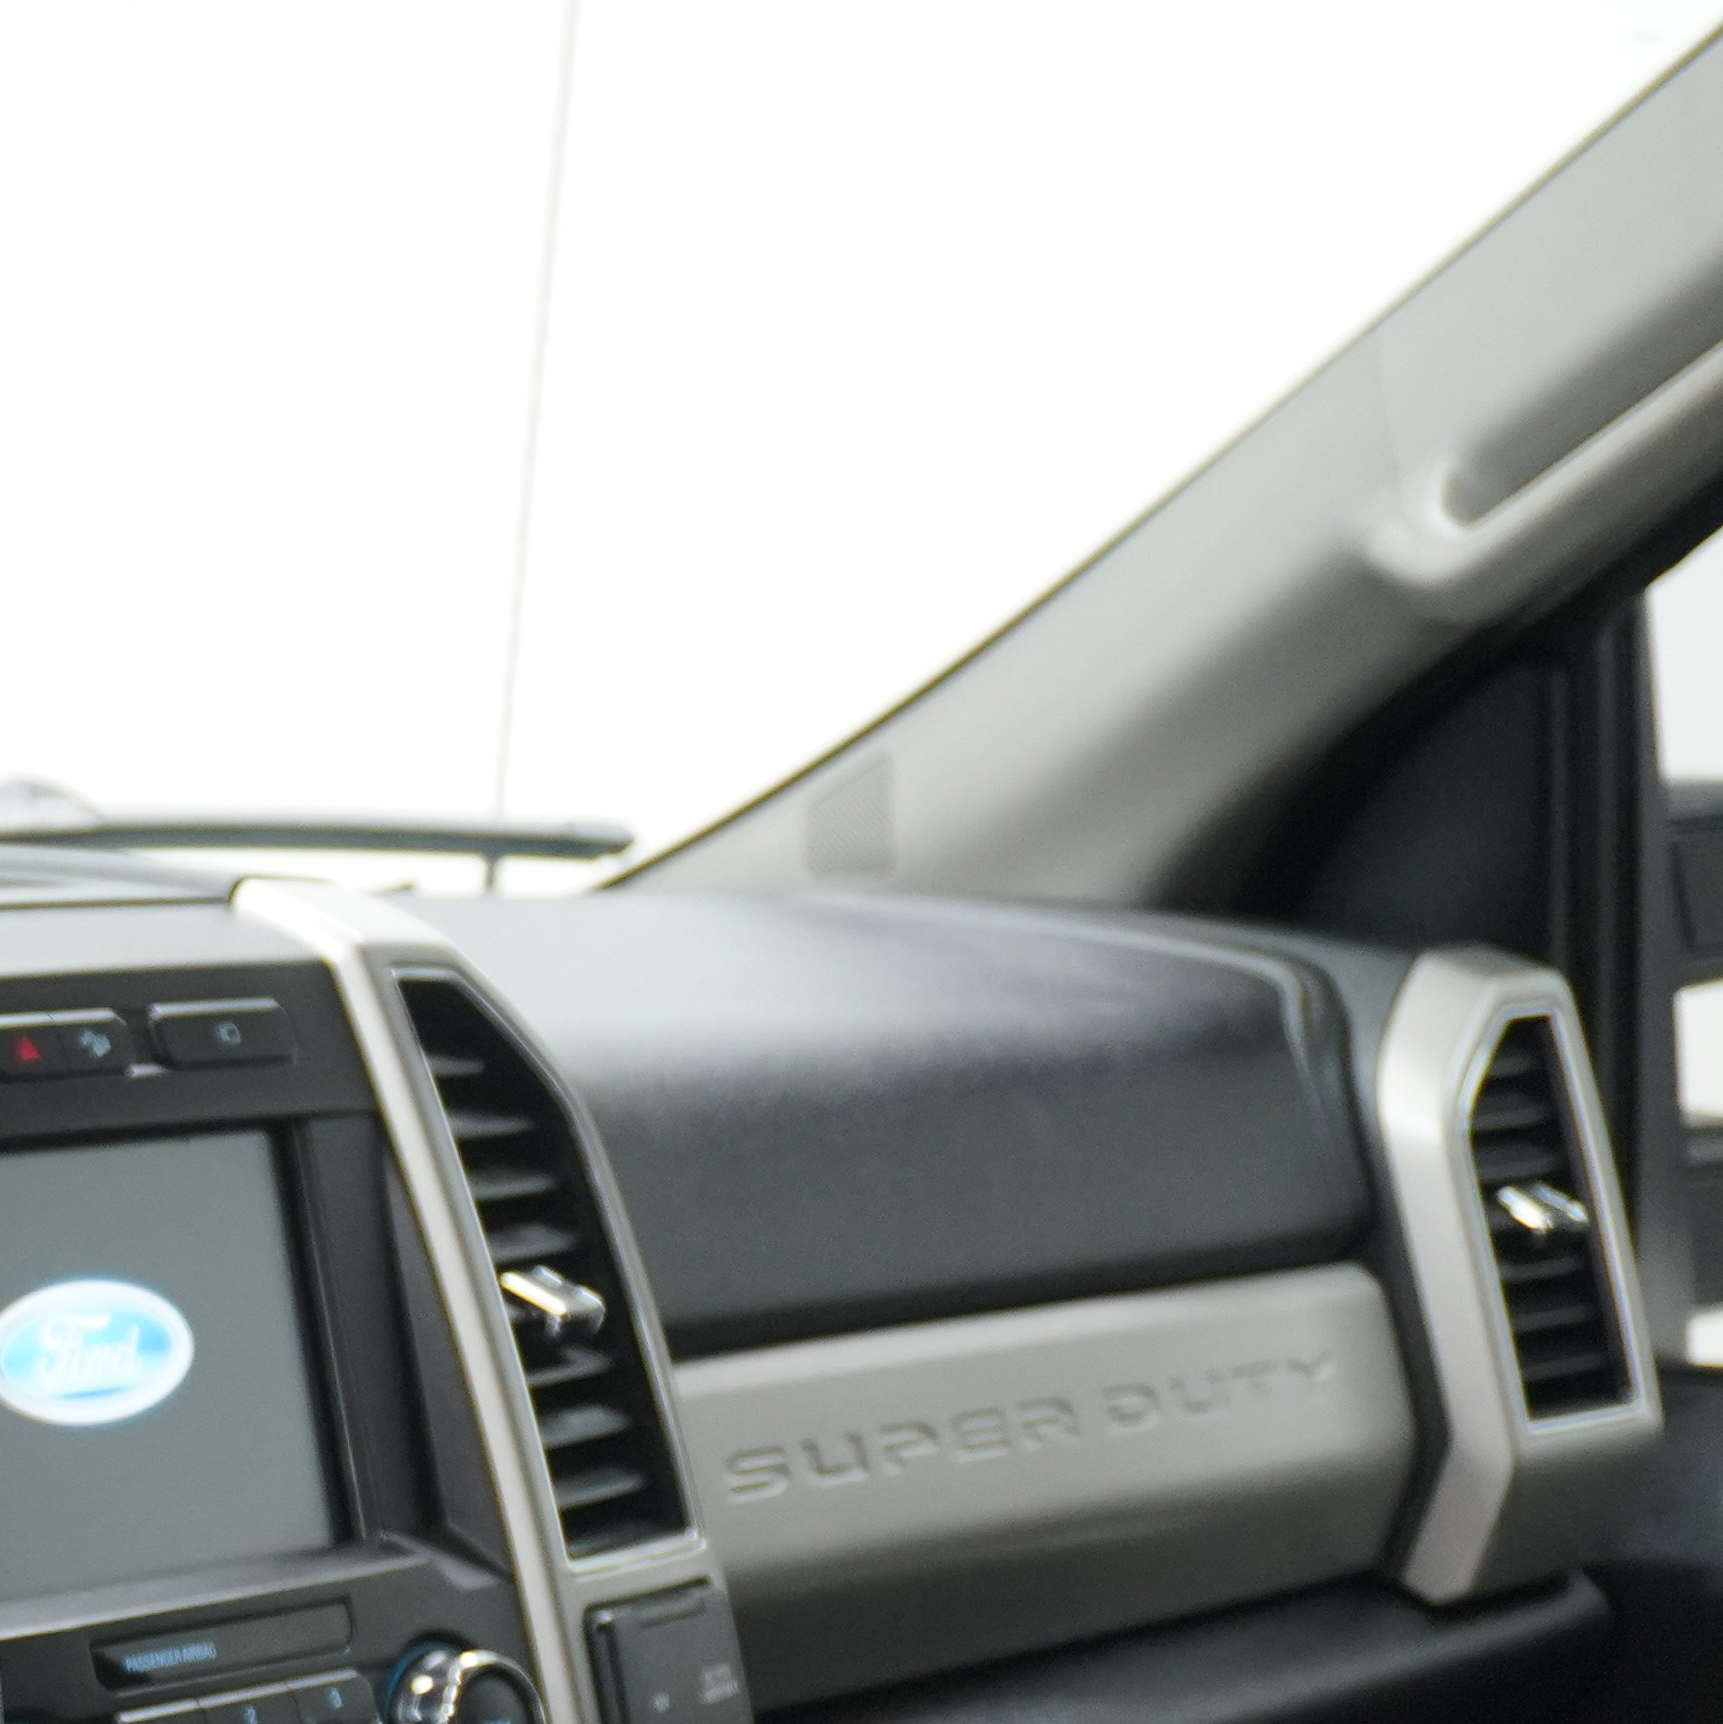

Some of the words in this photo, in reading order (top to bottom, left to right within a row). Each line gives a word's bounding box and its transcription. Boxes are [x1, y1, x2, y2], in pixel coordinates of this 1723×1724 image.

[40, 1313, 145, 1388] Ford
[723, 1397, 1081, 1502] SUPER
[1100, 1350, 1336, 1436] DUTY
